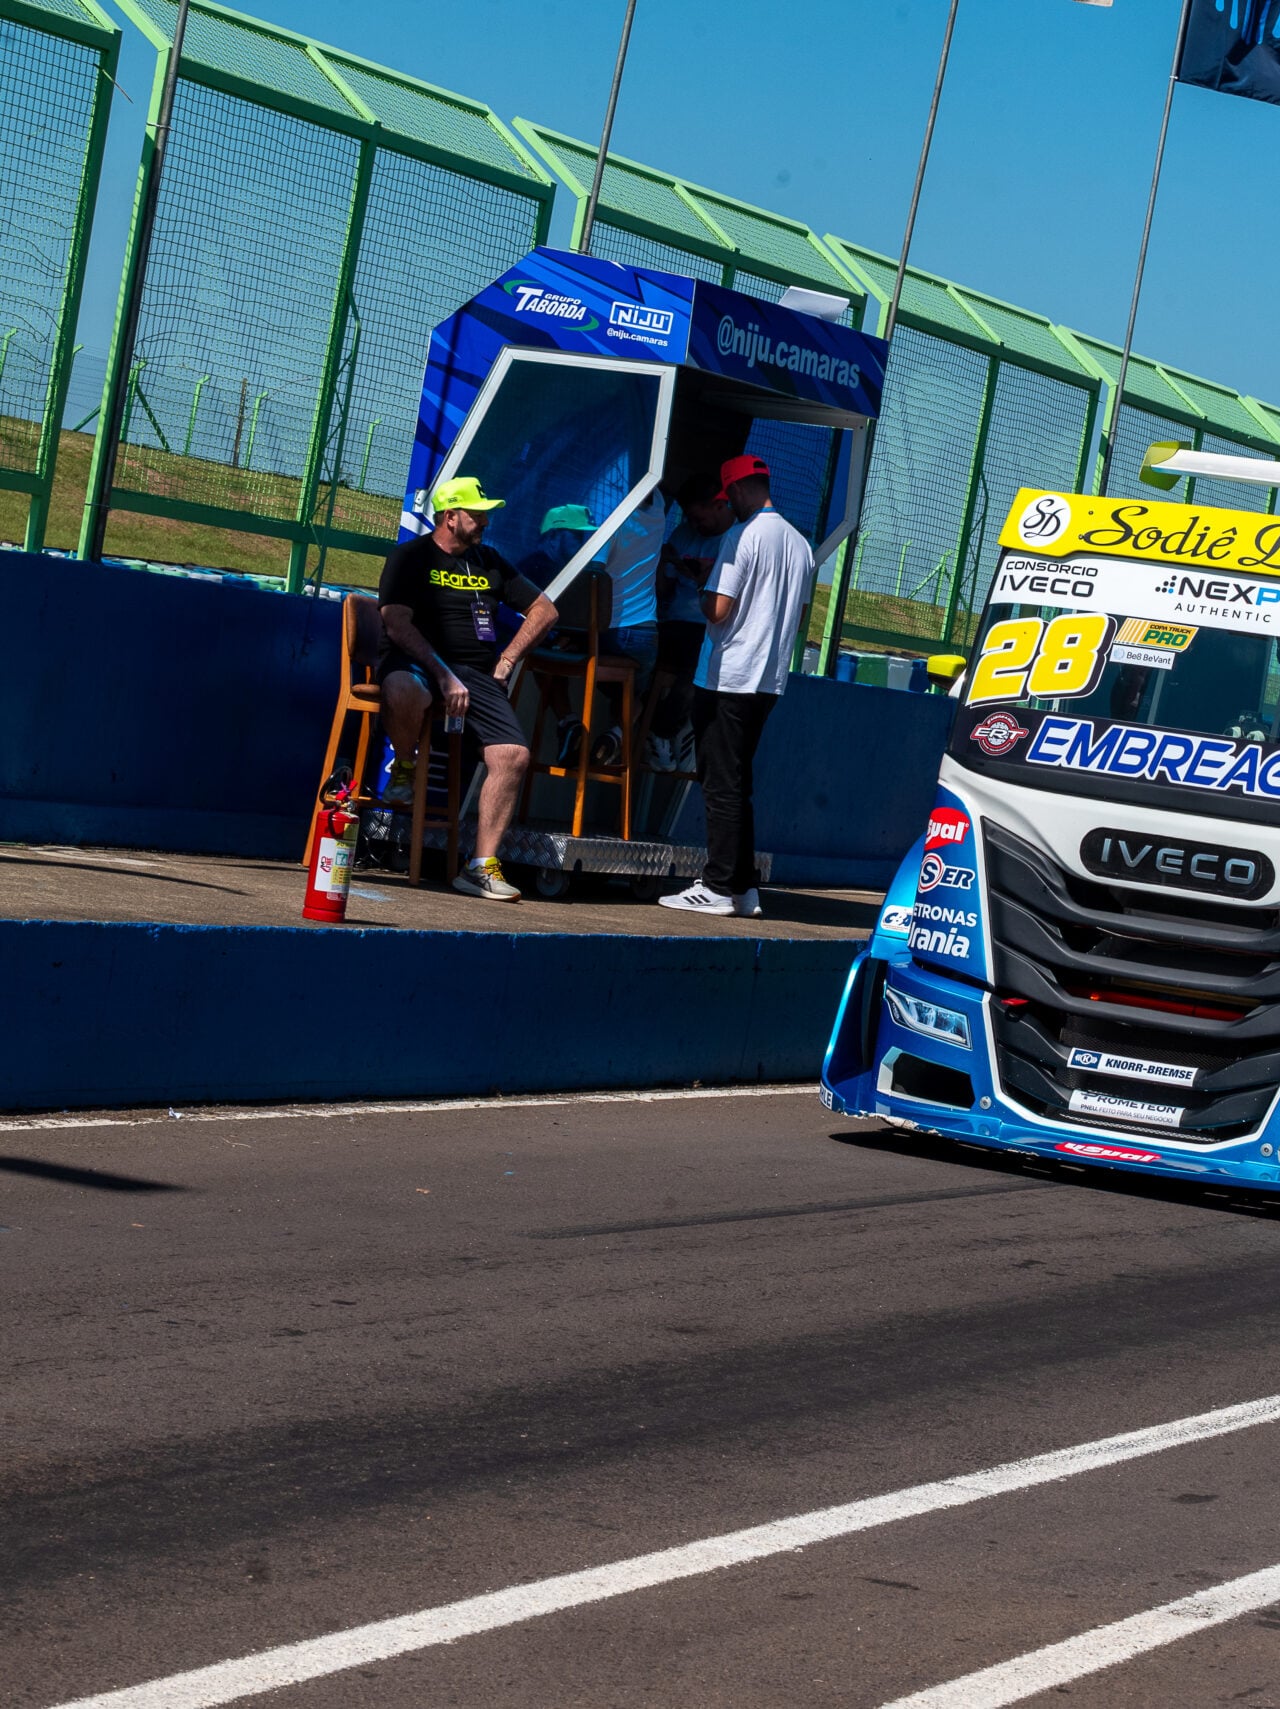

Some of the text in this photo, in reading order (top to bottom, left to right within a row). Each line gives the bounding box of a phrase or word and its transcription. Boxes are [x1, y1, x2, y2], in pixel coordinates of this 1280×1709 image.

[515, 286, 587, 321] TABORDA
[544, 293, 582, 305] GRUPO
[606, 327, 669, 347] @niju.camaras
[716, 315, 861, 390] @niju.camaras
[1083, 505, 1238, 560] Sodiê
[430, 569, 490, 591] sparco
[1000, 574, 1095, 598] IVECO
[1174, 602, 1271, 625] AUTHENTIC
[1142, 629, 1188, 647] PRO
[966, 613, 1113, 706] 28
[1126, 651, 1171, 665] Be8 BeVant
[925, 818, 966, 845] sual
[1100, 837, 1256, 885] IVECO
[919, 857, 975, 890] SER
[913, 902, 978, 928] ETRONAS
[1105, 1057, 1194, 1080] KNORR-BREMSE
[1080, 1091, 1177, 1114] PROMETEON
